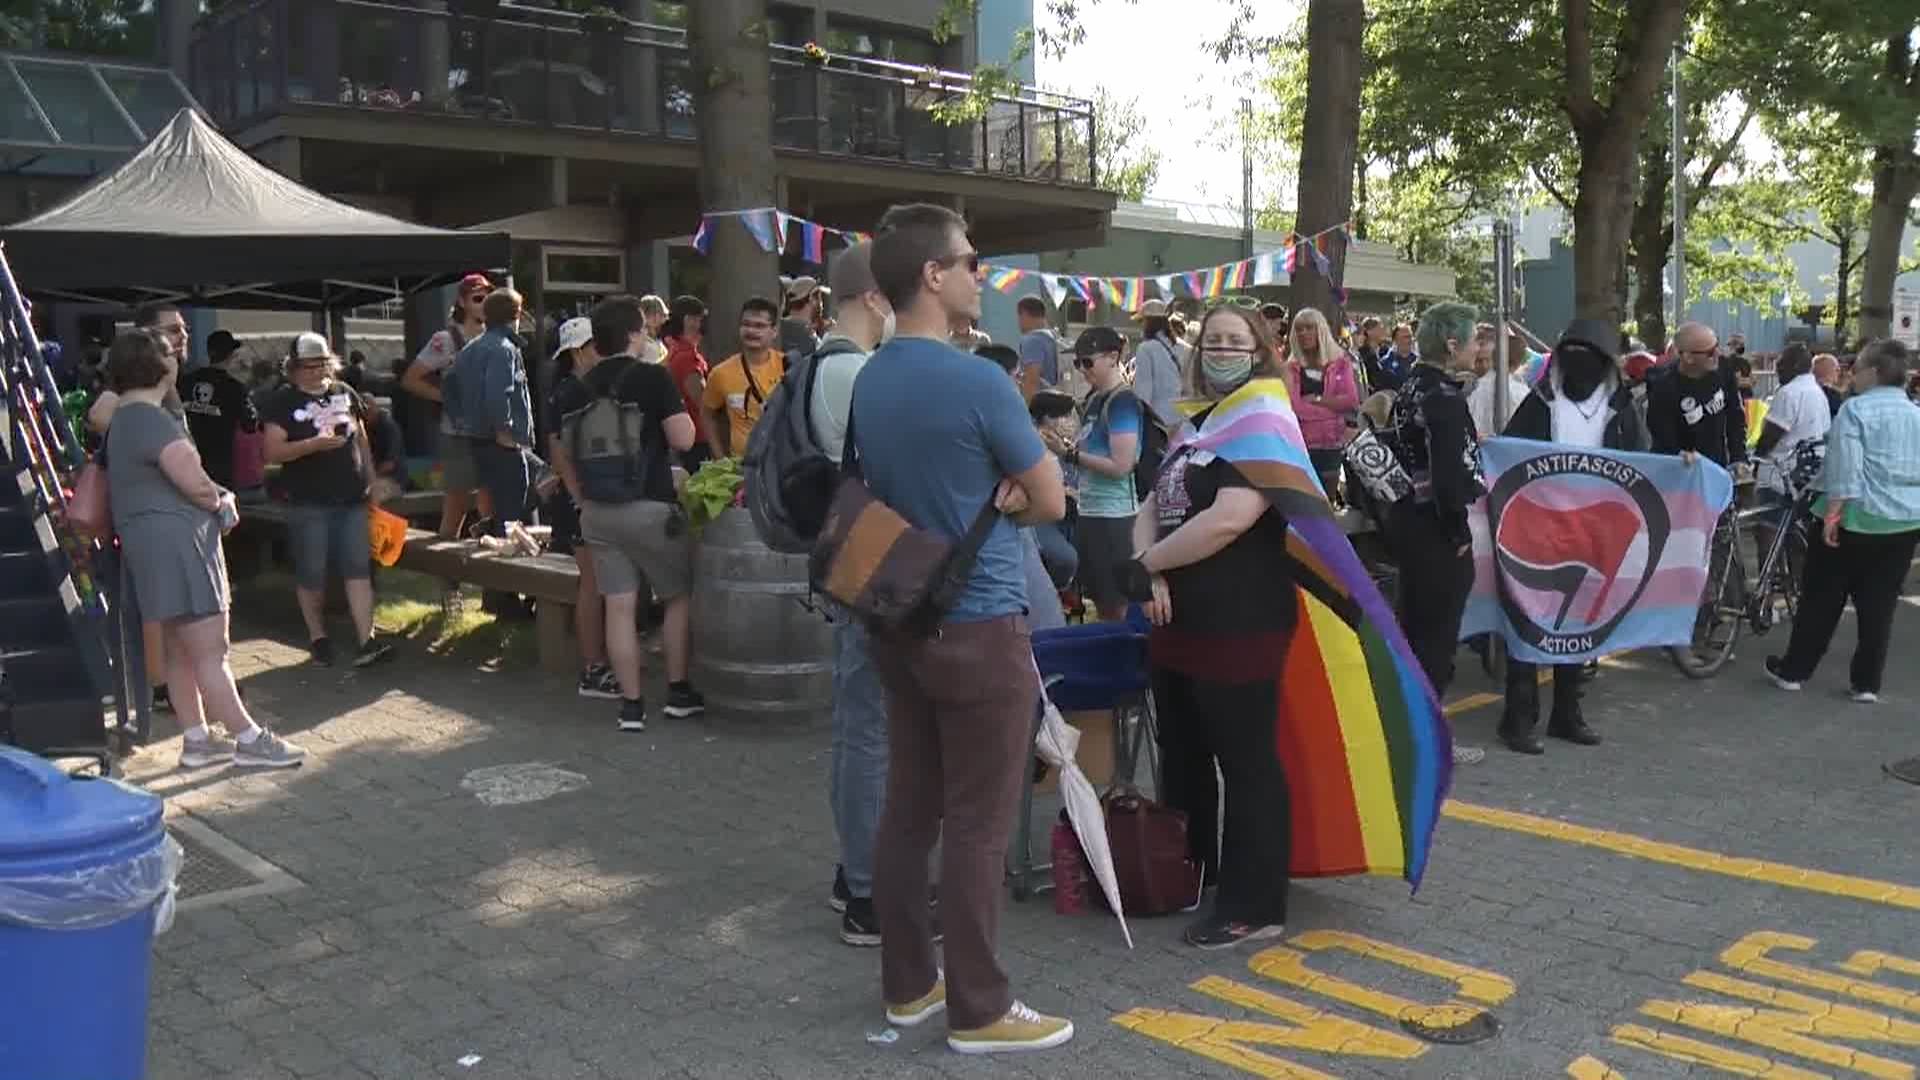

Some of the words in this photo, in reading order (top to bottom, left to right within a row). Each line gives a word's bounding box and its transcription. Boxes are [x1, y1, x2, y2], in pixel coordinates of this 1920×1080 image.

[1526, 455, 1643, 487] ANTIFASCIST
[1538, 635, 1593, 653] ACTION
[1110, 930, 1518, 1080] NO
